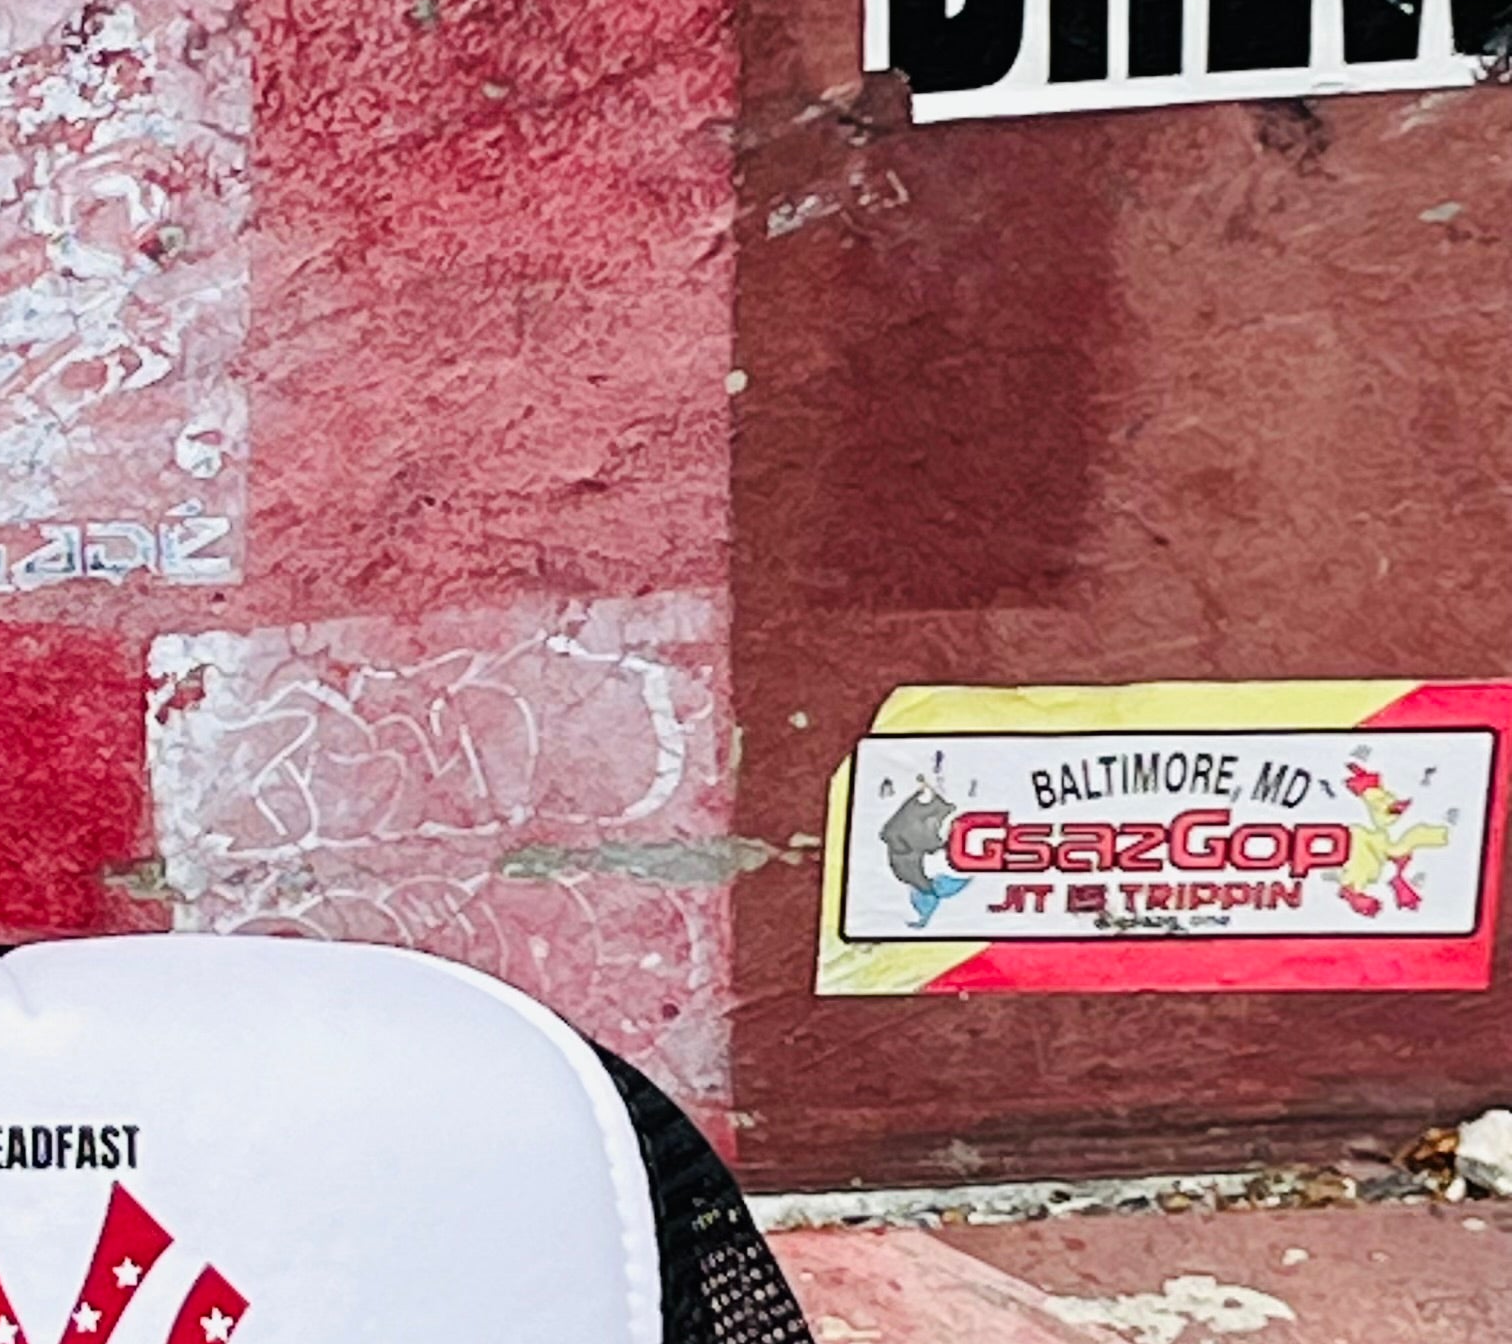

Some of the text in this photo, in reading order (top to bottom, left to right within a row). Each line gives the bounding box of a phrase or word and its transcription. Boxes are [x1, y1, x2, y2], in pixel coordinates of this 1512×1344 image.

[1031, 752, 1310, 811] BALTIMORE, MD
[1118, 881, 1304, 912] TRIPPIN
